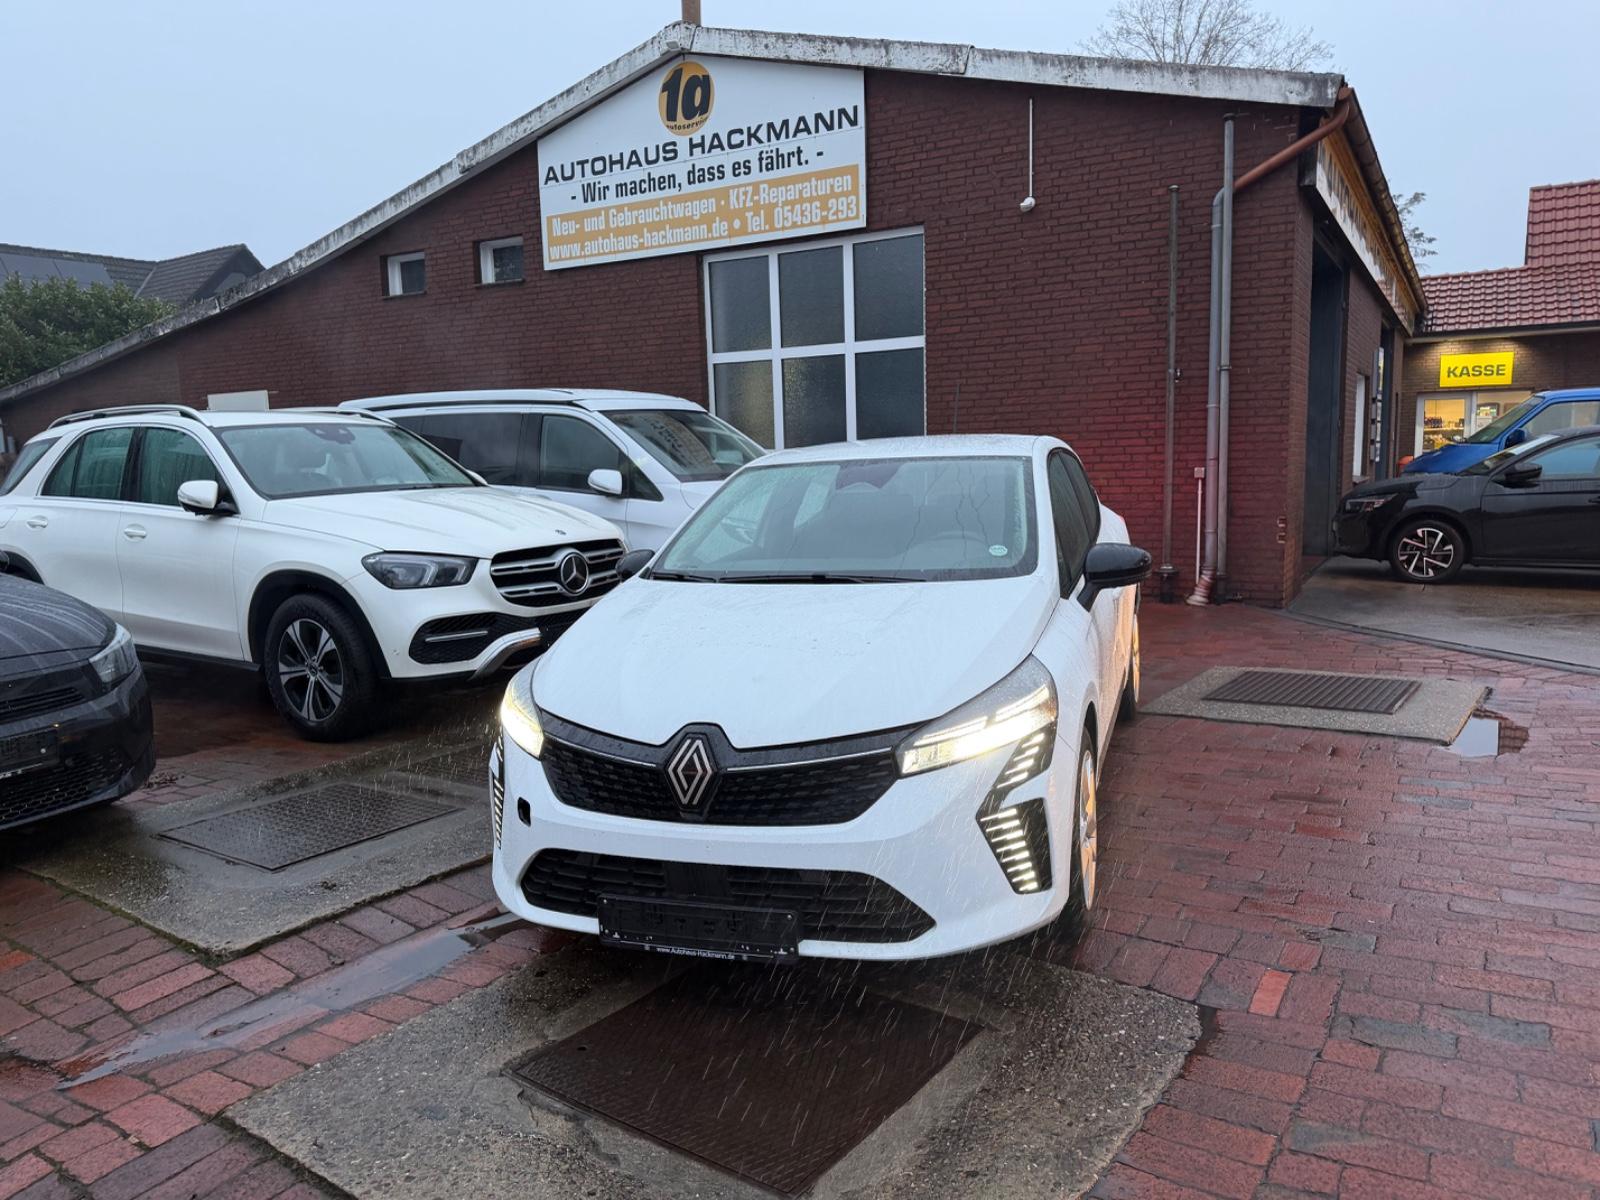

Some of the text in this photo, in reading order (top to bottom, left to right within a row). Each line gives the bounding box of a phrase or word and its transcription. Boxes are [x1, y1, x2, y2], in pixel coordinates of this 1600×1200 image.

[544, 105, 859, 185] AUTOHAUS HACKMANN
[666, 117, 708, 131] autoservi
[582, 181, 610, 204] Wir
[615, 172, 682, 198] machen,
[687, 163, 725, 185] dass
[732, 159, 752, 178] es
[758, 146, 809, 173] fährt.
[549, 195, 857, 260] www.autohaus-hackmann.de Tel. 05436-293
[552, 175, 852, 237] Neu- und Gebrauchtwagen KFZ-Reparaturen
[1447, 364, 1506, 378] KASSE
